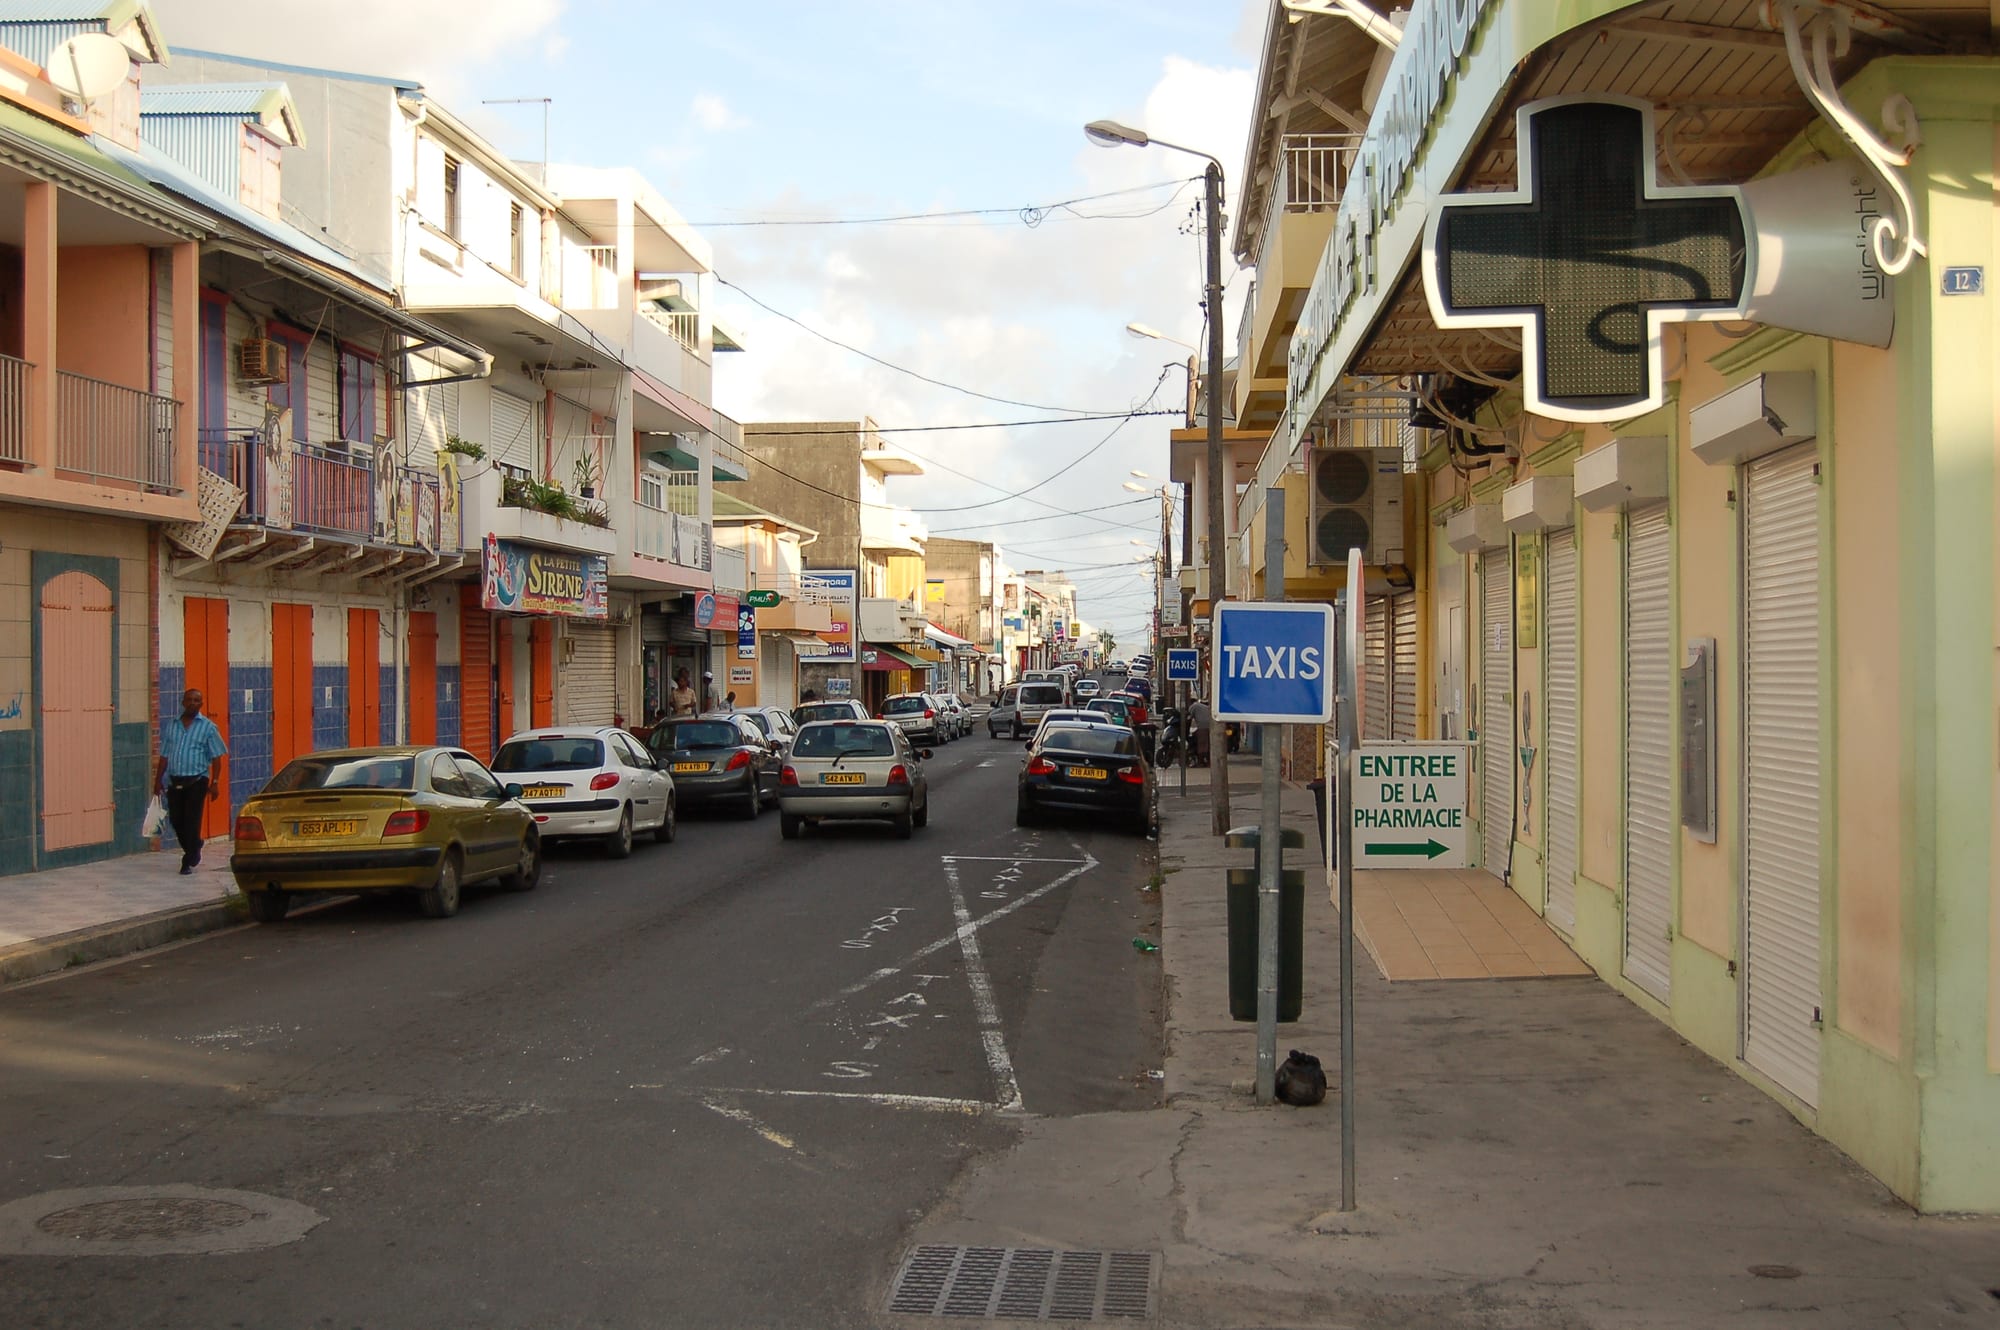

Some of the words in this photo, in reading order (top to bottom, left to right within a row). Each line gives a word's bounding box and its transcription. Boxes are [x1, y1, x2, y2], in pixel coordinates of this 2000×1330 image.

[1954, 272, 1969, 290] 12
[543, 556, 554, 567] LA
[556, 558, 581, 572] PETITE
[528, 553, 584, 599] SIRENE
[749, 596, 768, 604] PMU
[1170, 659, 1196, 670] TAXIS
[1223, 644, 1321, 681] TAXIS
[1359, 755, 1457, 777] ENTREE
[1380, 783, 1404, 803] DE
[1412, 783, 1437, 803] LA
[1354, 808, 1462, 828] PHARMACIE
[302, 823, 321, 835] 653
[322, 822, 341, 834] APL
[840, 906, 915, 951] TAXIS
[822, 974, 951, 1080] TAXIS
